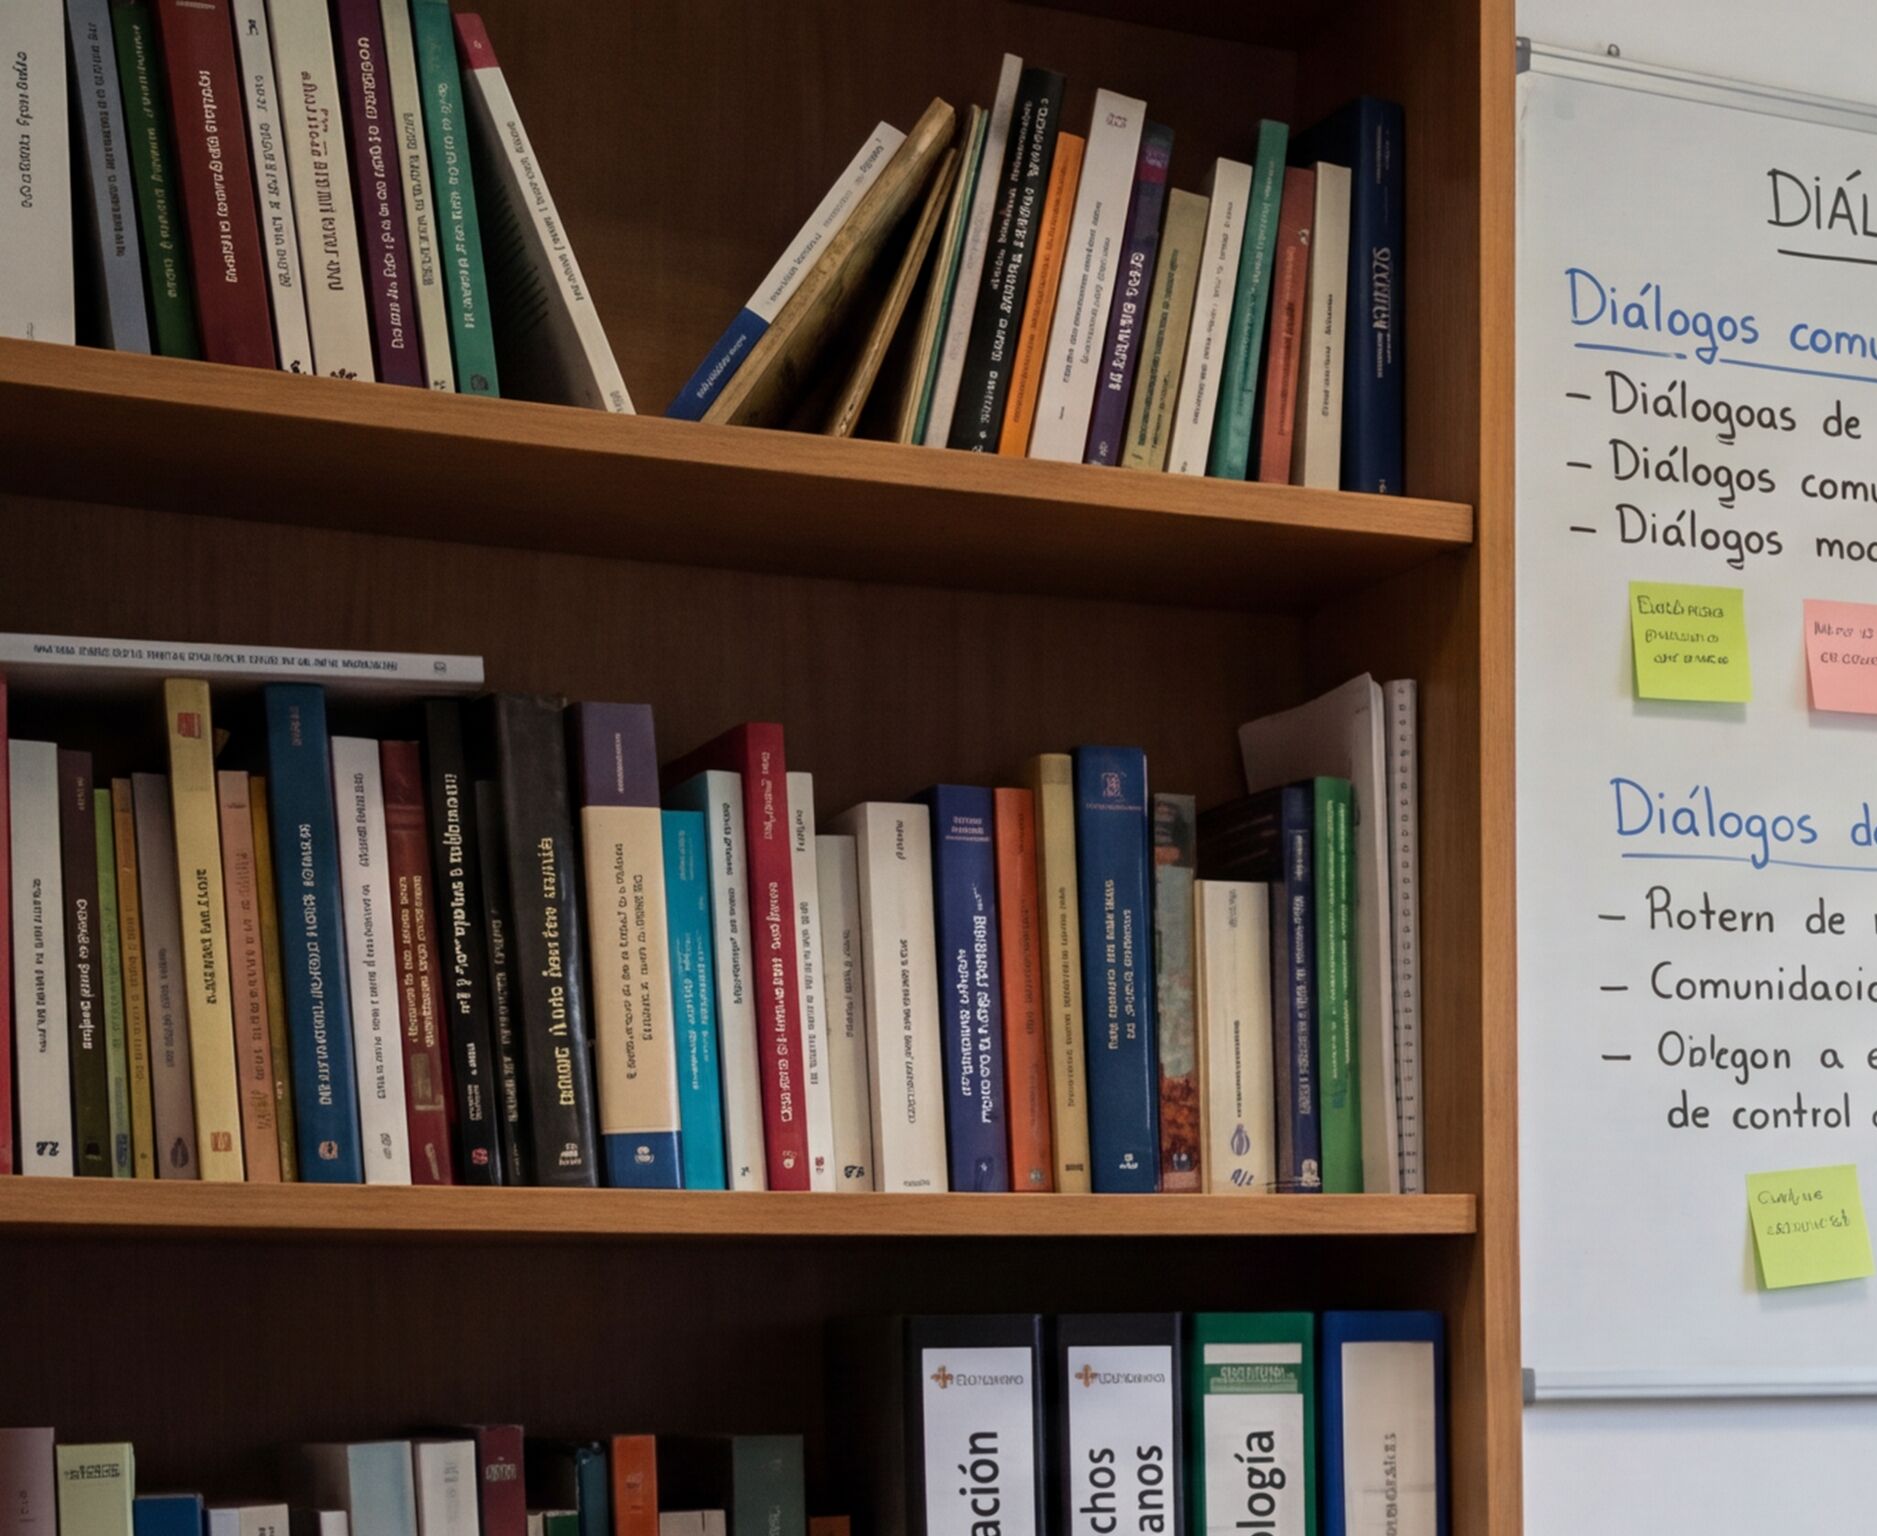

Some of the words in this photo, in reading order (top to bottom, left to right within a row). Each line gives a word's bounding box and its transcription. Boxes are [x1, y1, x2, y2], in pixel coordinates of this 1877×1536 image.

[1565, 266, 1760, 364] Diálogos
[1823, 400, 1862, 441] de
[1608, 438, 1777, 510] Diálogos
[1614, 504, 1784, 571] Diálogos
[1609, 777, 1820, 869] Diálogos
[1805, 897, 1847, 936] de
[1820, 1047, 1845, 1071] a
[1667, 1088, 1710, 1130] de
[1732, 1091, 1851, 1131] control
